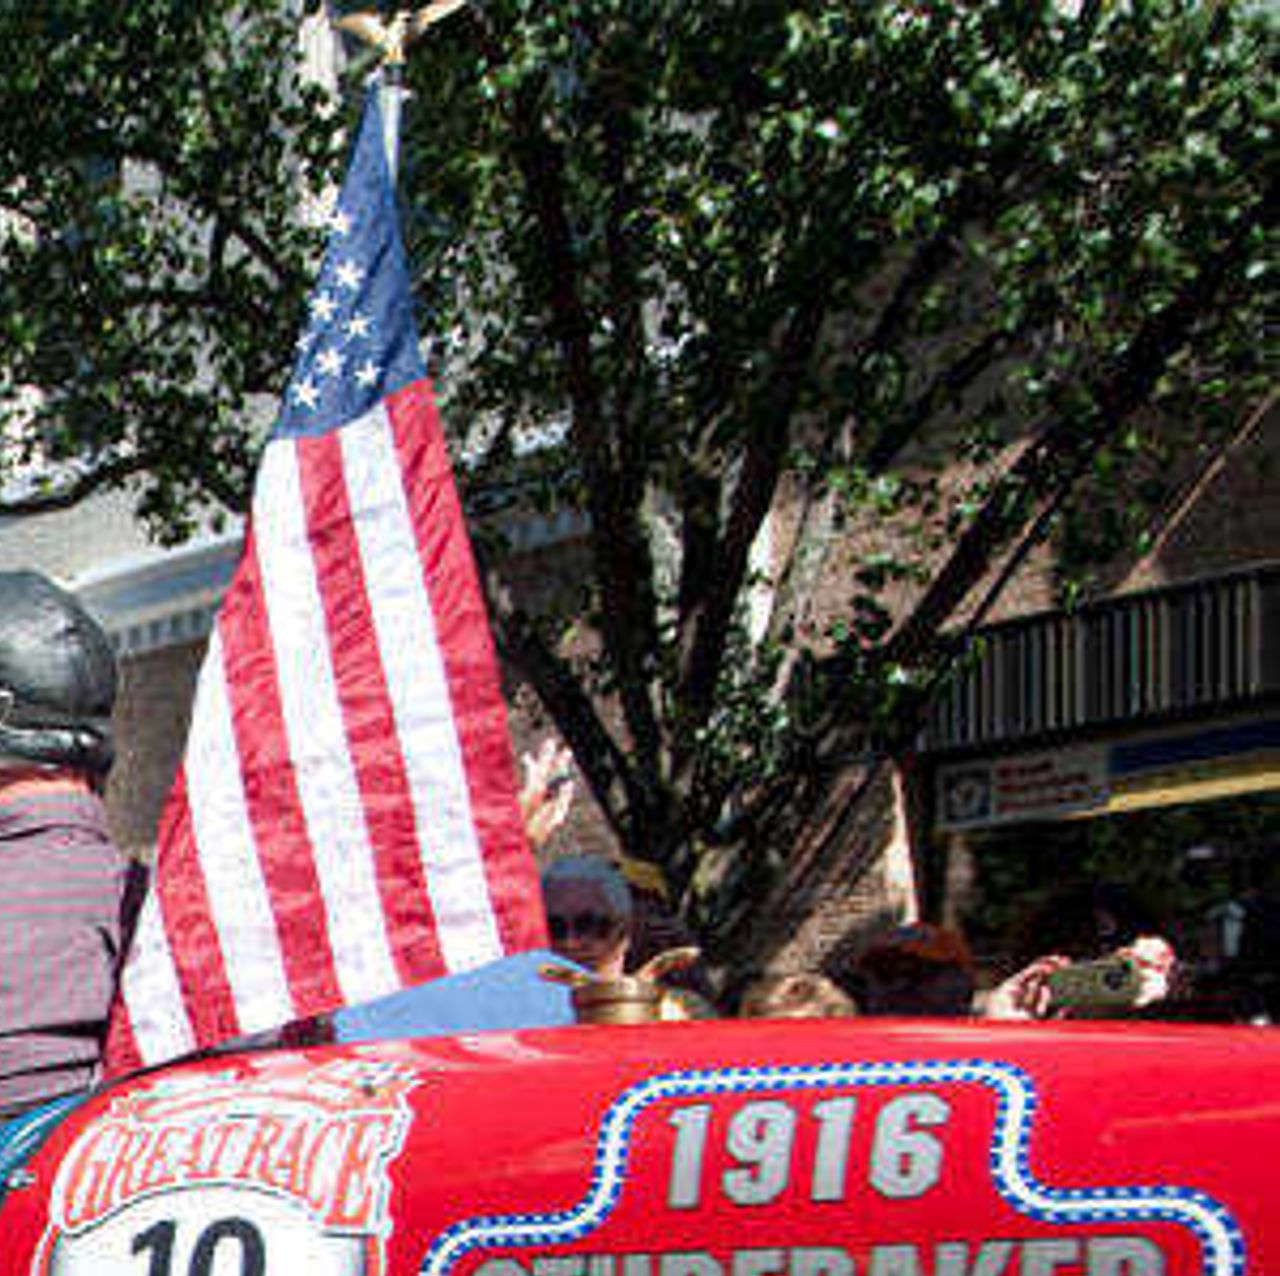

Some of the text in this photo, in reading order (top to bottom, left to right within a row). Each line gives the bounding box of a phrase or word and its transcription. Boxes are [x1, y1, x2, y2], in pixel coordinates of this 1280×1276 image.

[64, 1113, 395, 1229] GREAT RACE
[666, 1093, 952, 1209] 1916
